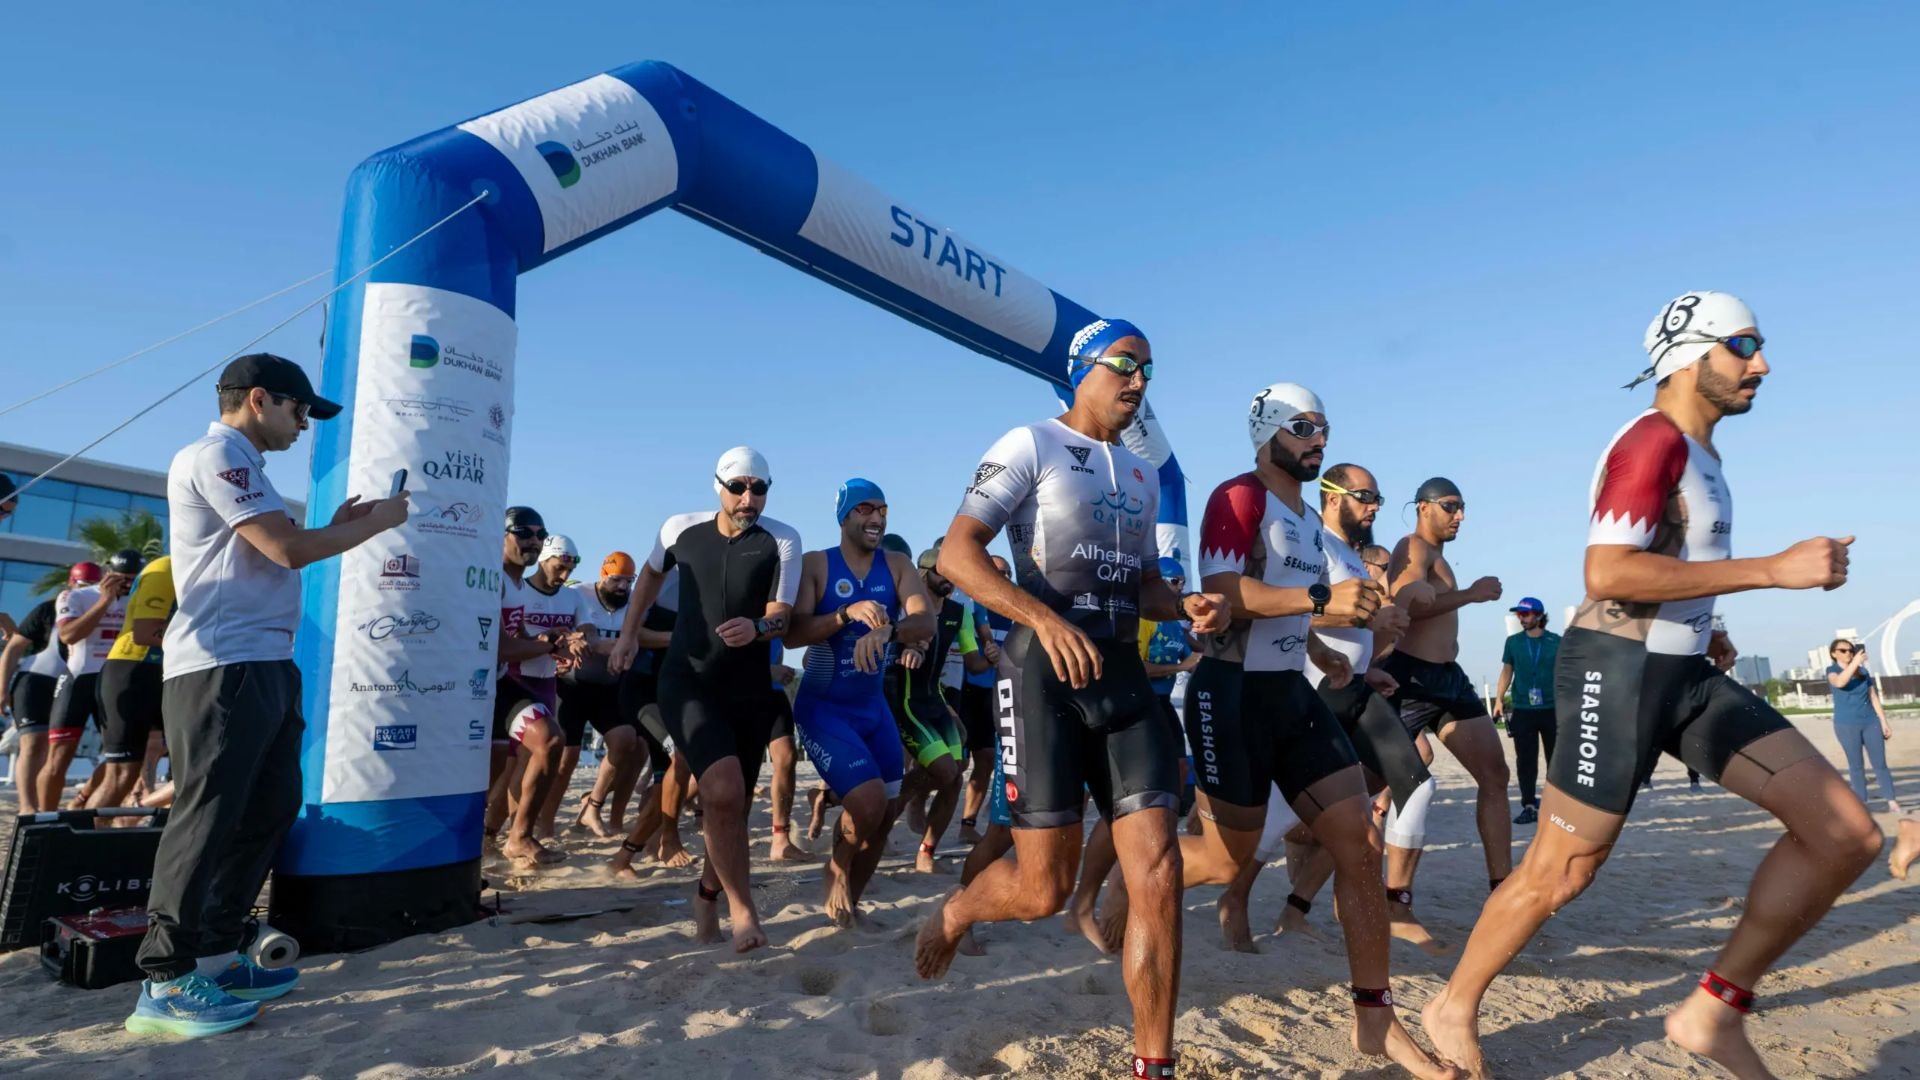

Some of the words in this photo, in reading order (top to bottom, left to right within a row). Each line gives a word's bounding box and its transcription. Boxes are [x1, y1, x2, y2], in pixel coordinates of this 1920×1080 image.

[581, 145, 622, 168] DUKHAN
[622, 132, 647, 151] BANK
[890, 205, 1007, 297] START
[443, 356, 483, 374] DUKHAN
[484, 368, 502, 382] BANK
[445, 450, 485, 469] visit
[422, 461, 484, 485] QATAR
[1097, 563, 1131, 583] QAT
[1283, 556, 1321, 574] SEASHOR
[531, 614, 572, 625] QATAR
[350, 682, 404, 693] Anatomy
[375, 734, 410, 742] SWEAT
[997, 678, 1018, 776] QTRI
[1577, 671, 1602, 788] SEASHORE
[1198, 691, 1219, 786] SEASHORE
[1550, 813, 1576, 833] VELO
